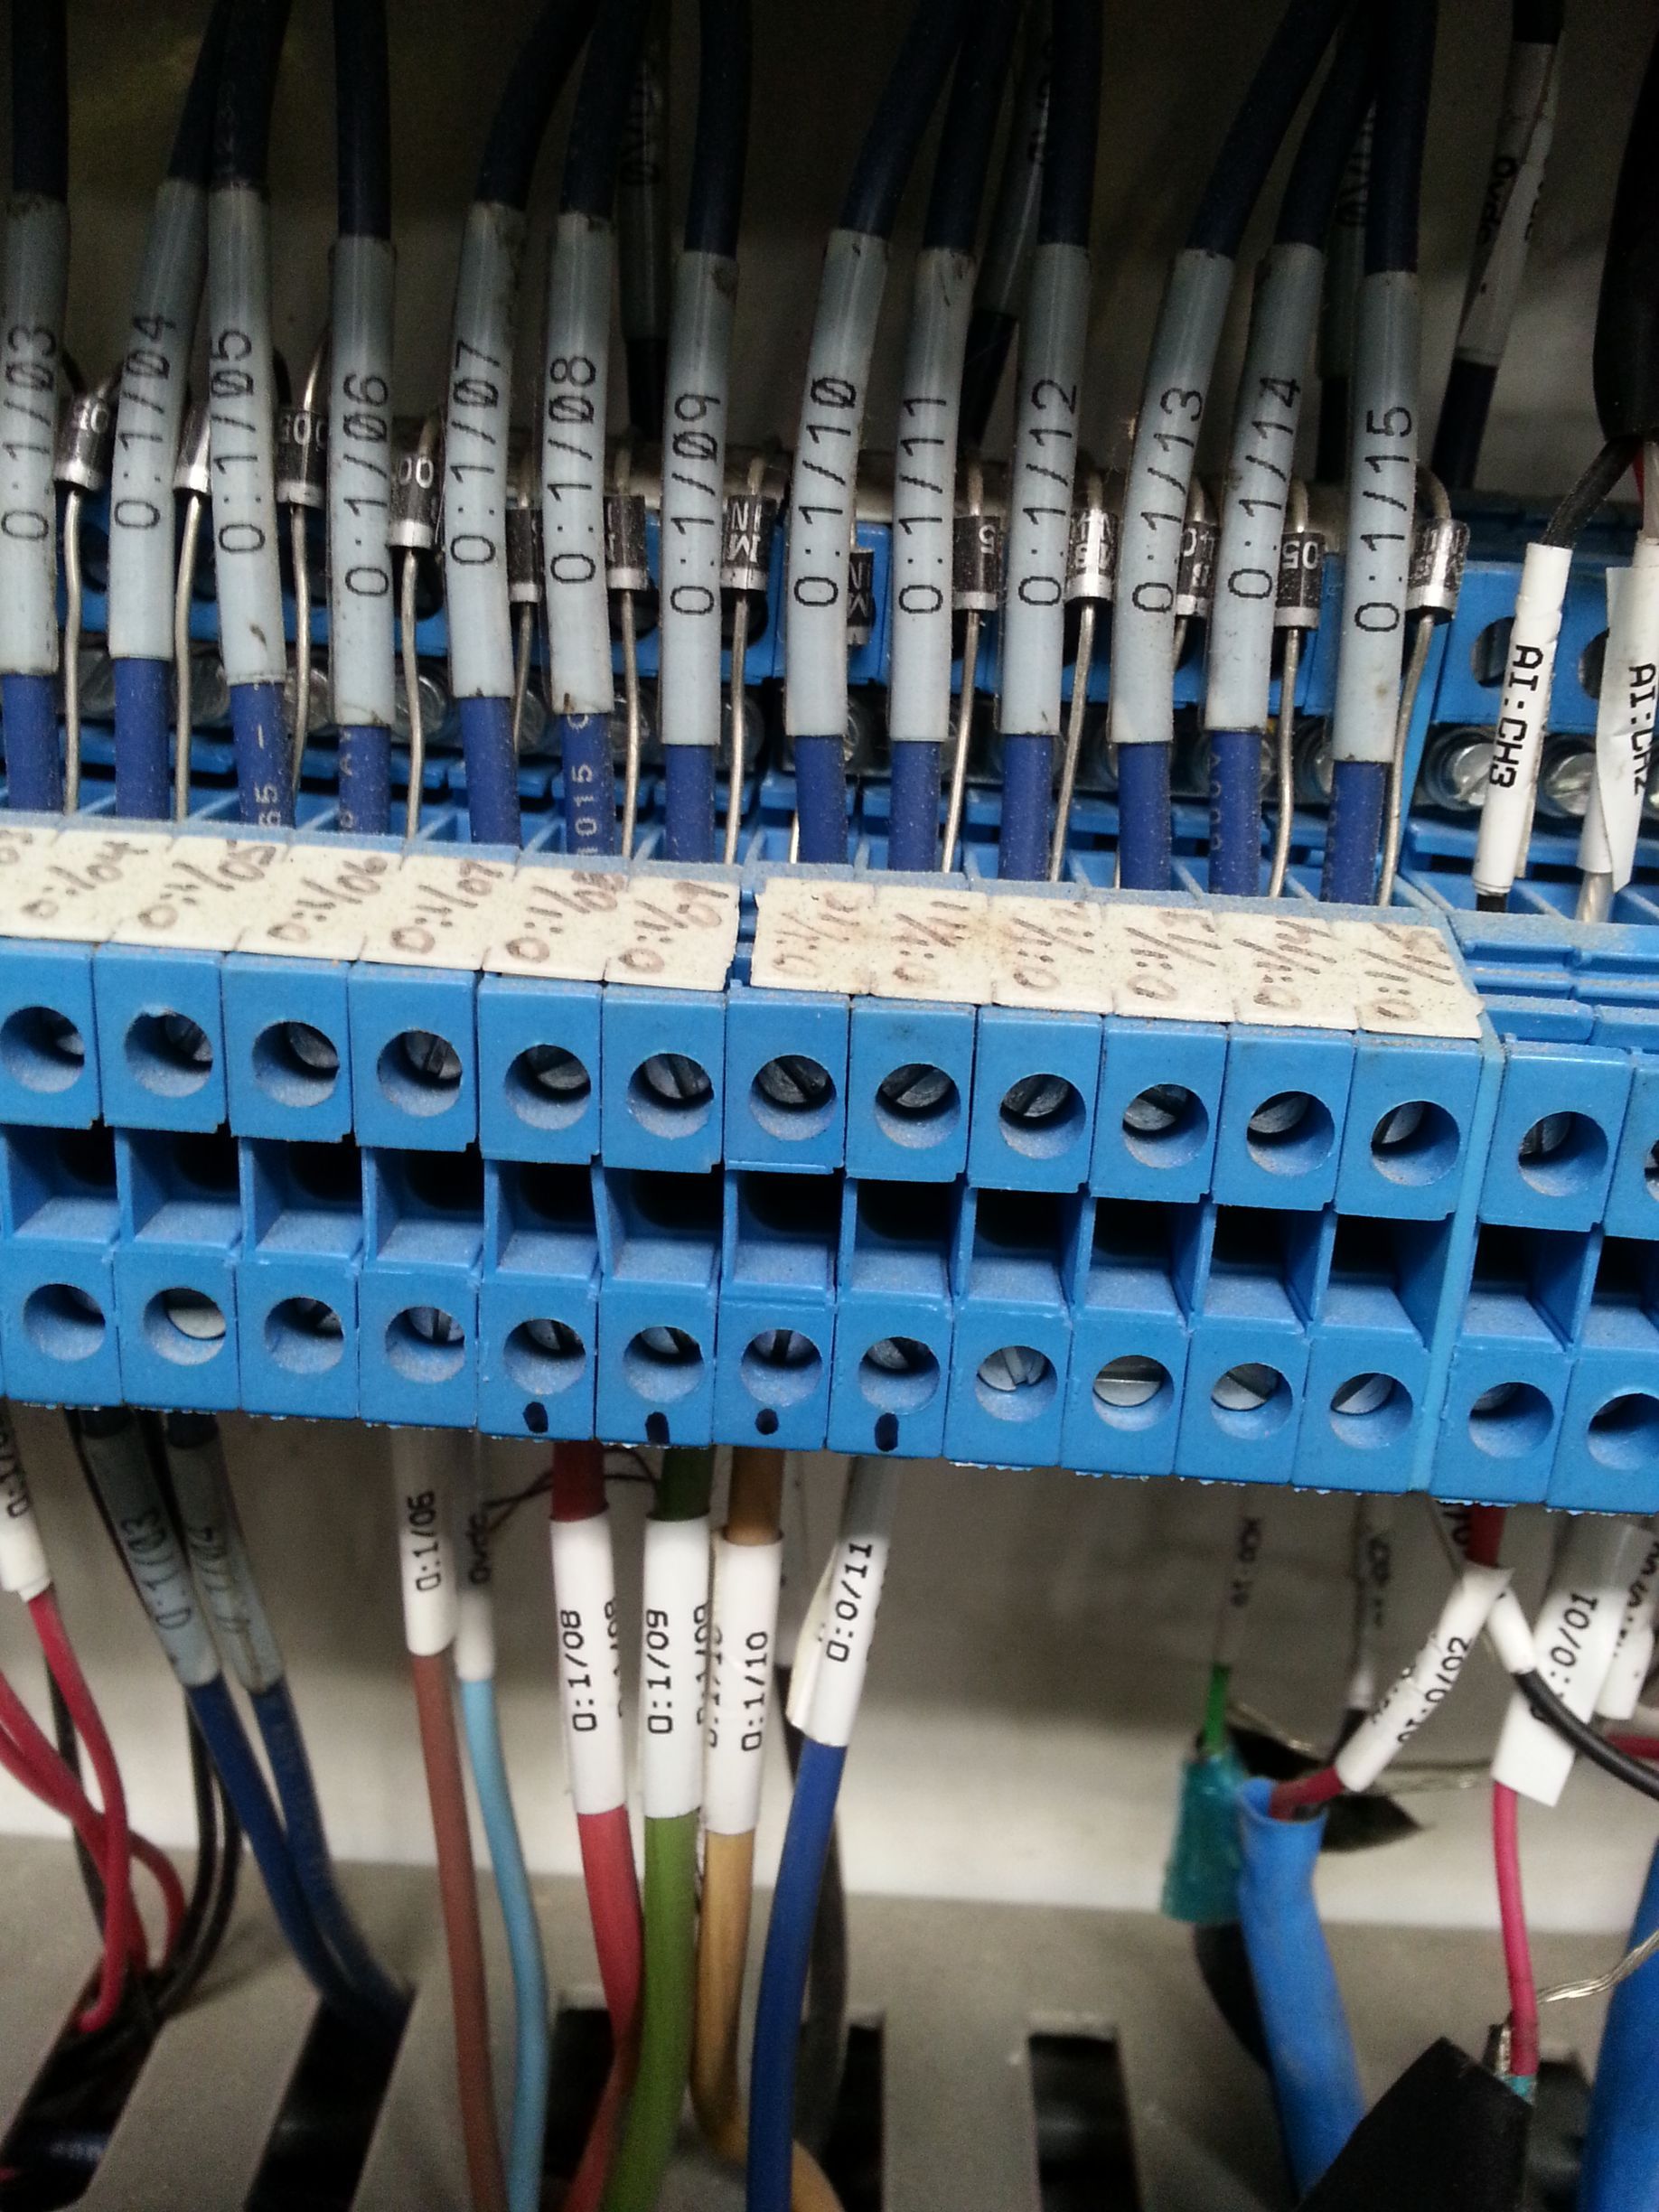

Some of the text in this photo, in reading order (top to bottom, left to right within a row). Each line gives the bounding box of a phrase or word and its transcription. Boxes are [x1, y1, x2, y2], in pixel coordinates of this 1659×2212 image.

[211, 328, 266, 553] 0:1/05
[342, 372, 389, 597] 0:1/06
[451, 339, 501, 566] 0:1/07
[547, 355, 597, 584] 0:1/08
[670, 393, 721, 615] 0:1/09
[793, 377, 858, 607] 0:1/10
[897, 397, 948, 614] 0:1/11
[1017, 378, 1077, 607] 0:1/12
[1131, 387, 1204, 613] 0:1/13
[1227, 375, 1302, 600] 0:1/14
[1354, 405, 1413, 633] 0:1/15
[1488, 643, 1544, 789] AI:CH3
[559, 1608, 598, 1732] 0:1/08
[646, 1608, 674, 1735] 0:1/09
[740, 1630, 769, 1752] 0:1/10
[825, 1542, 873, 1663] 0:0/11
